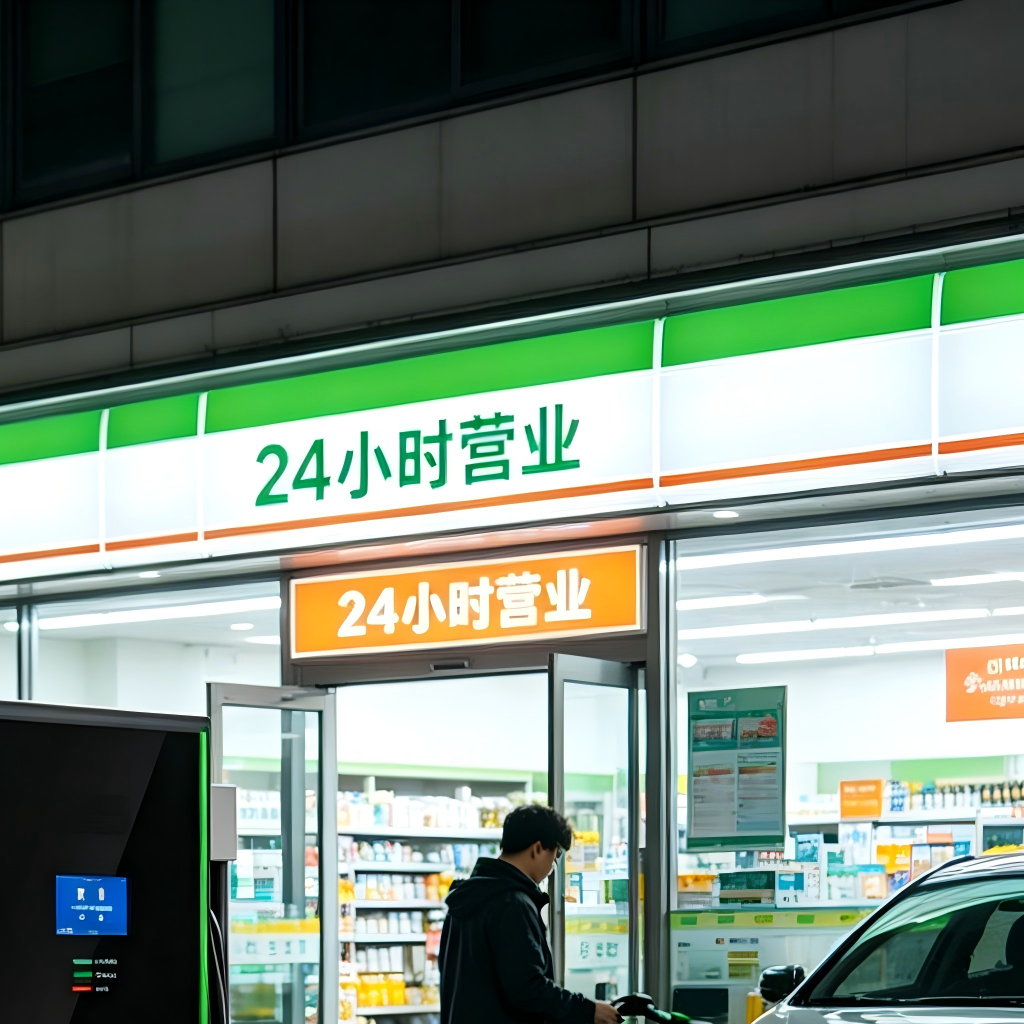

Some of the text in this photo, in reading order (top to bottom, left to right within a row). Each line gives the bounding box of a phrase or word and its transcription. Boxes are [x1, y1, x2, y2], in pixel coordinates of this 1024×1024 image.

[255, 403, 581, 507] 24小时营业
[337, 567, 593, 638] 24小时营业
